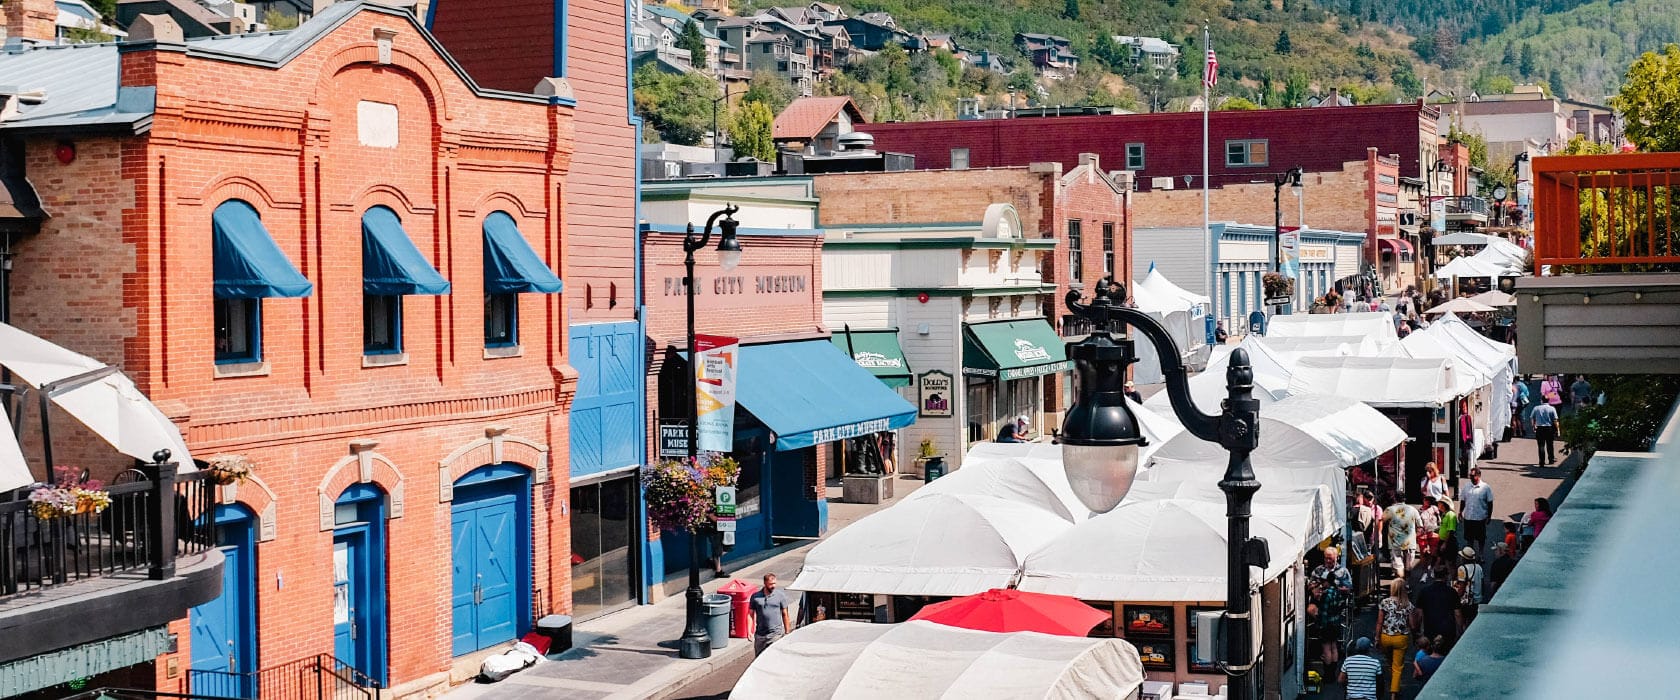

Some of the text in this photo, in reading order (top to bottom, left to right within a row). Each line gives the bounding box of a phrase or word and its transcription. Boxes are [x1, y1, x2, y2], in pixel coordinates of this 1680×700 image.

[664, 275, 805, 296] PAK CITY MUSEUM
[923, 378, 948, 386] DOLLY'S
[663, 428, 684, 438] PARK
[813, 417, 890, 444] PARK CITY MUSEUM
